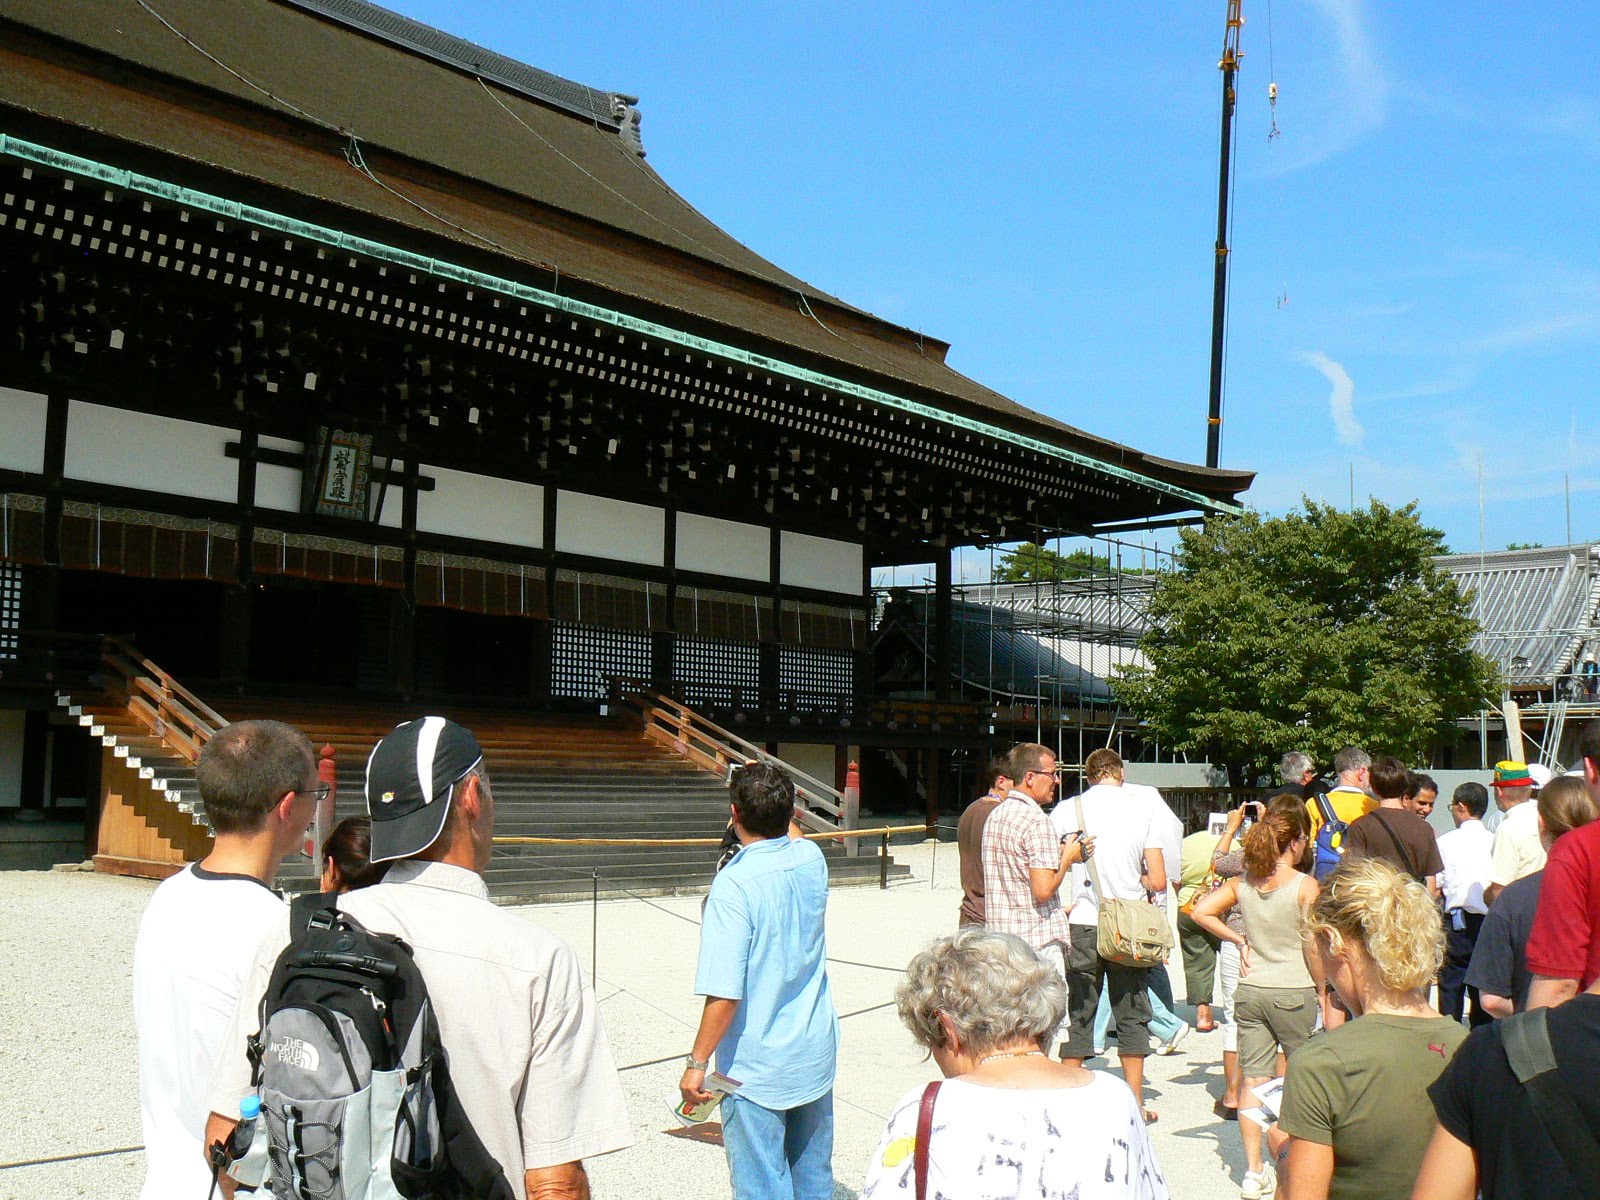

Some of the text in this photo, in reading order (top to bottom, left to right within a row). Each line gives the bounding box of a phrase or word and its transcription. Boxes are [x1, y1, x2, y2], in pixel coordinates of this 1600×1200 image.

[283, 1036, 303, 1049] THE
[270, 1041, 302, 1060] NORTH
[278, 1052, 301, 1067] FACE
